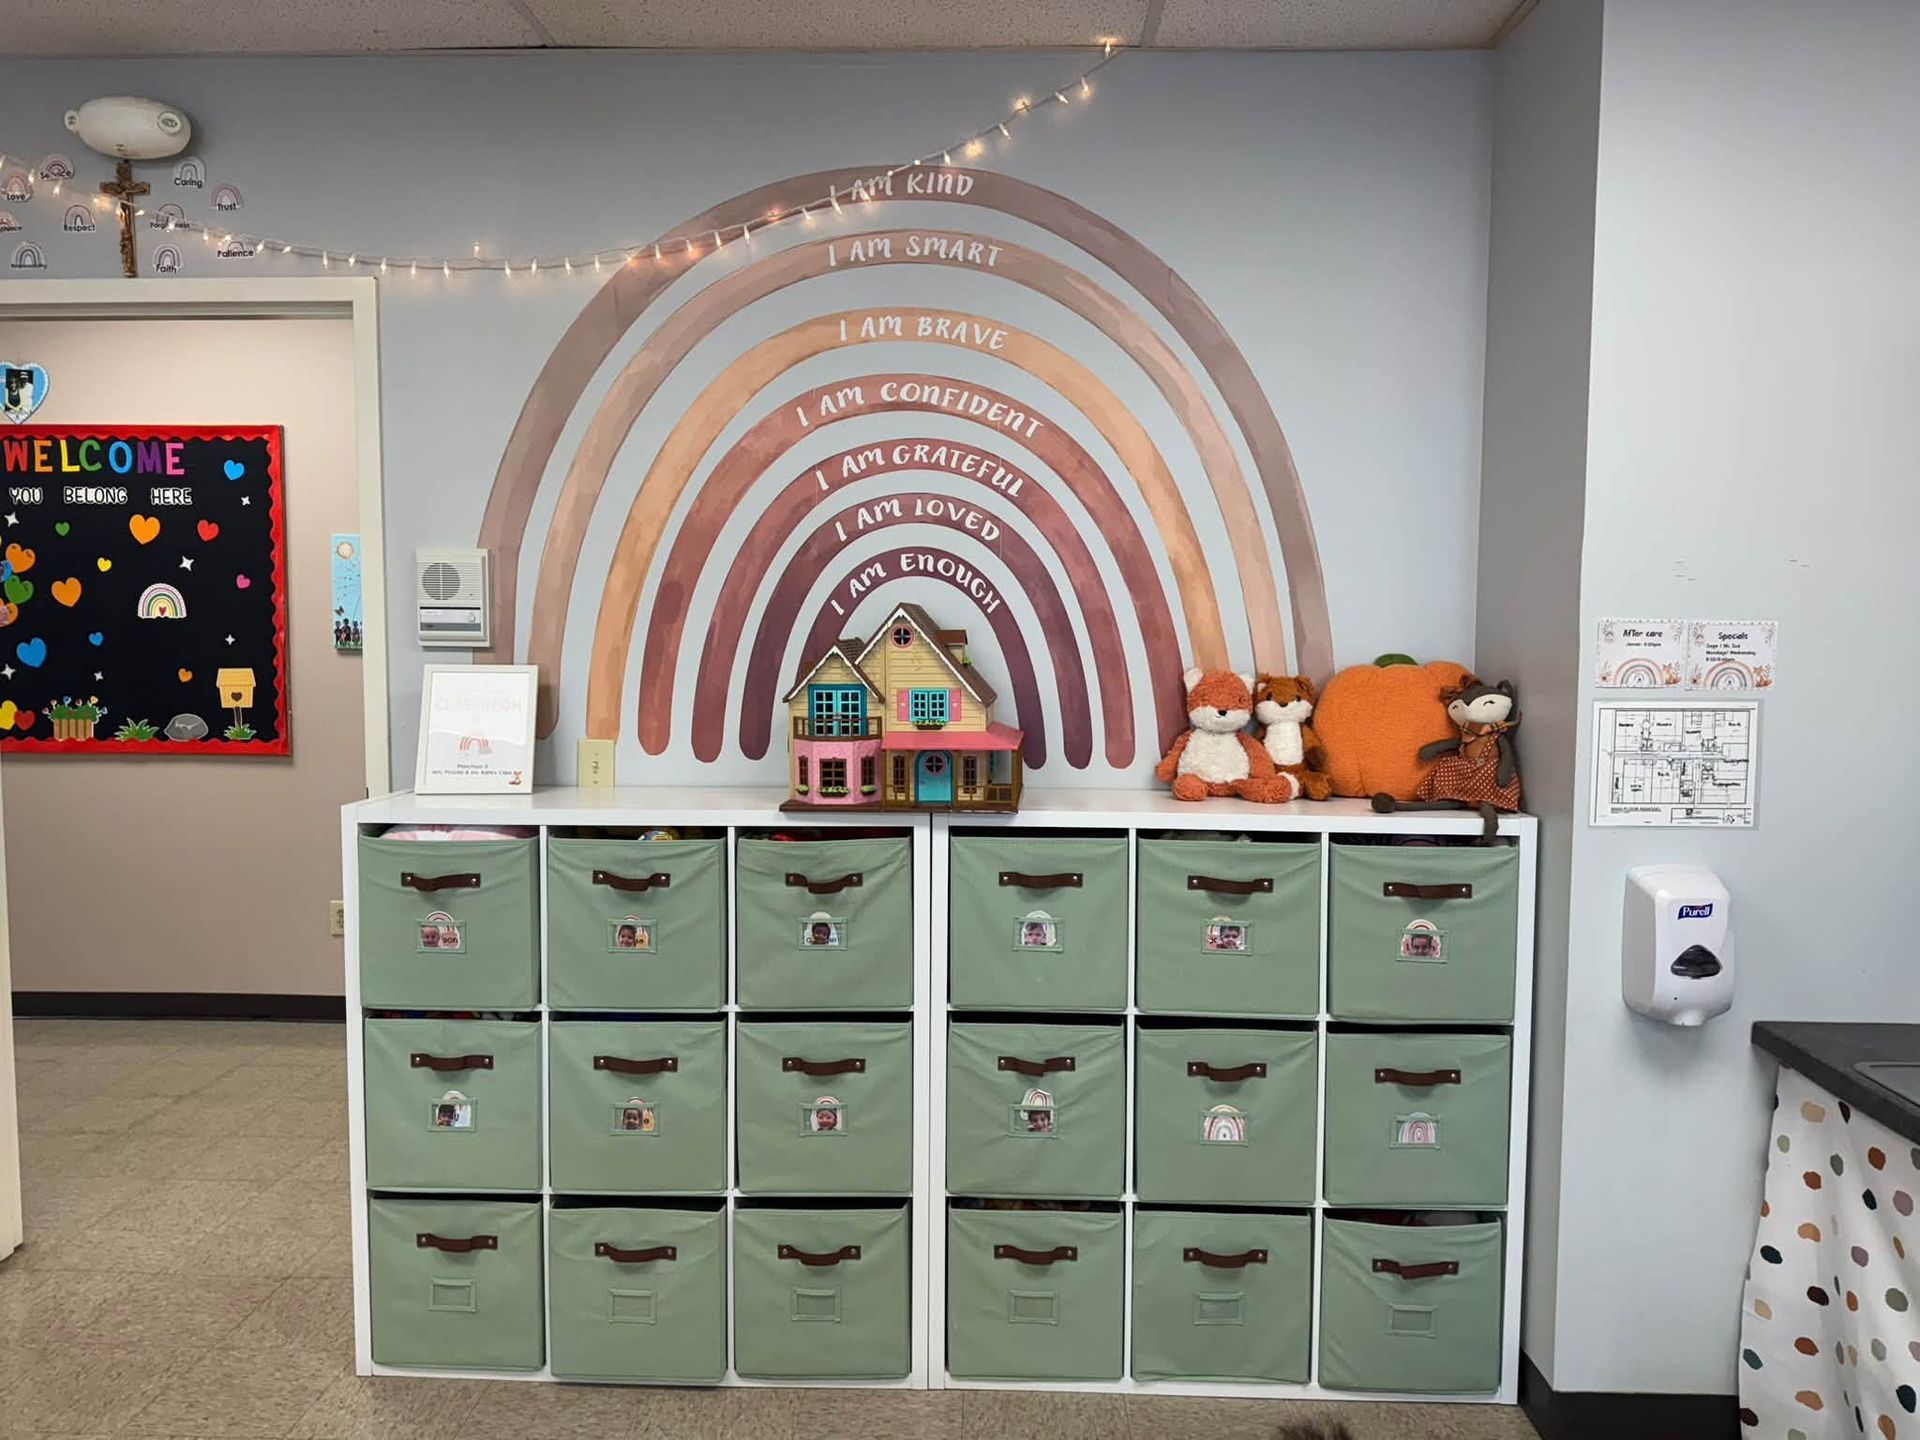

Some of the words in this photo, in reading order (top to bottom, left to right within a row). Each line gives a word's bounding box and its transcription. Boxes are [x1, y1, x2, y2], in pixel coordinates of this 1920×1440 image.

[40, 170, 72, 180] Sevice
[174, 178, 203, 189] Caring
[852, 173, 893, 200] AM
[907, 172, 974, 196] KIND
[6, 193, 26, 201] Love
[217, 203, 237, 211] Trust
[64, 224, 96, 232] Respect
[217, 249, 254, 258] Patience
[828, 244, 836, 266] I
[850, 237, 892, 263] AM
[906, 235, 1003, 267] SMART
[156, 264, 177, 273] Faith
[839, 319, 847, 341] I
[860, 315, 903, 338] AM
[917, 315, 1009, 350] BRAVE
[796, 406, 809, 427] I
[820, 385, 865, 416] AM
[880, 382, 1044, 438] CONFIDENT
[3, 439, 186, 475] WELCOME
[815, 470, 829, 491] I
[841, 447, 885, 478] AM
[892, 443, 1024, 497] GRATEFUL
[9, 486, 44, 505] YOU
[63, 486, 129, 505] BELONG
[150, 487, 193, 506] HERE
[835, 521, 848, 542] I
[857, 498, 902, 529] AM
[914, 498, 1000, 541] LOVED
[830, 599, 845, 616] I
[850, 561, 887, 598] AM
[900, 553, 1001, 614] ENOUGH
[1718, 632, 1748, 641] Specials
